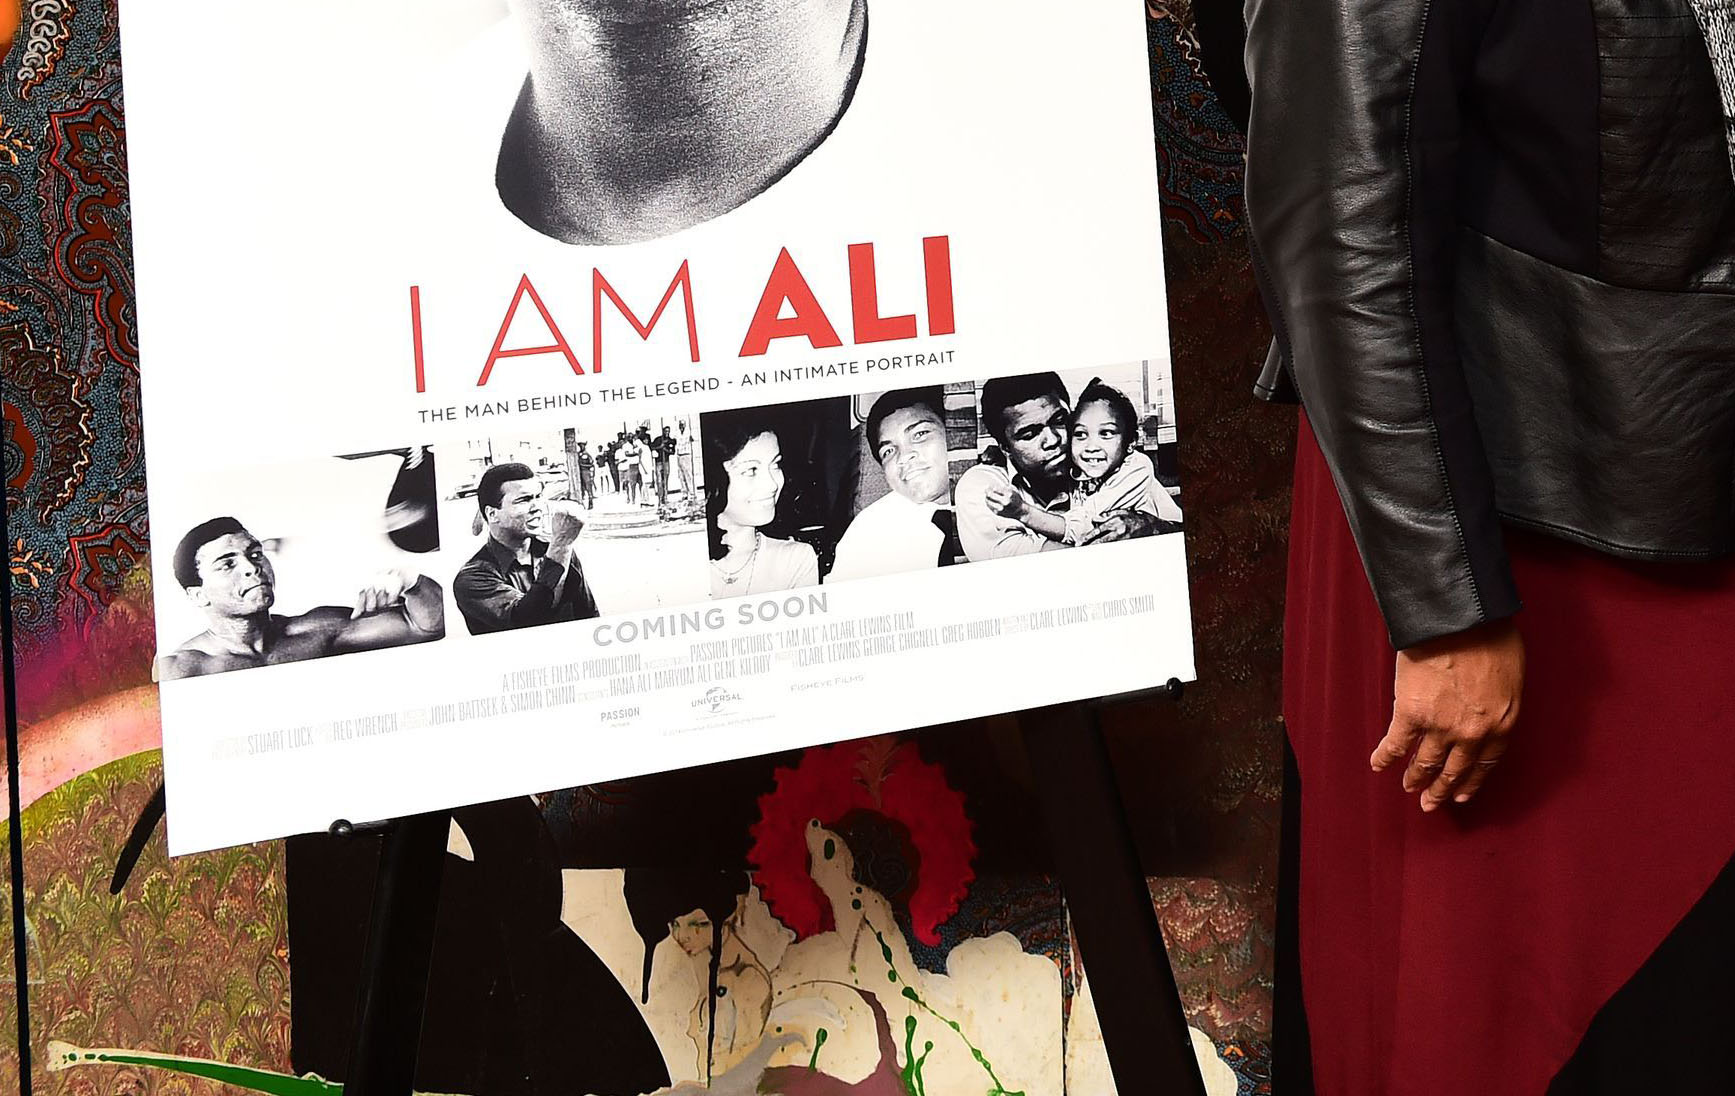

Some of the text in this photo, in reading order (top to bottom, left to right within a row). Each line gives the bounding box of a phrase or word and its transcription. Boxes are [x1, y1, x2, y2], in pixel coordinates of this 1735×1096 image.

[410, 235, 955, 393] I AM ALI
[418, 406, 457, 424] THE
[465, 402, 509, 421] MAN
[518, 391, 592, 413] BEHIND
[599, 385, 637, 403] THE
[644, 377, 720, 400] LEGEND
[741, 372, 767, 388] AN
[773, 361, 859, 384] INTIMATE
[866, 350, 955, 374] PORTRAIT
[503, 673, 510, 693] A
[511, 667, 549, 691] FISHEYE
[551, 662, 580, 685] FILMS
[583, 653, 641, 681] PRODUCTION
[690, 640, 728, 664] PASSION
[731, 632, 773, 657] PICTURES
[830, 619, 856, 642] CLARE
[894, 610, 914, 633] FILM
[593, 591, 828, 647] COMING SOON
[247, 730, 285, 756] STUART
[289, 725, 315, 749] LUCK
[333, 720, 352, 742] REG
[355, 712, 398, 738] WRENCH
[429, 702, 456, 727] JOHN
[510, 688, 543, 715] SIMON
[546, 684, 575, 709] CHINN
[610, 674, 636, 698] HANA
[799, 644, 825, 668] CLARE
[942, 622, 965, 646] GREG
[1029, 608, 1055, 632] CLARE
[1057, 603, 1089, 627] LEWINS
[1103, 597, 1127, 620] CHRIS
[1129, 592, 1155, 615] SMITH
[691, 692, 742, 709] UNIVERSAL
[601, 705, 640, 722] PASSION
